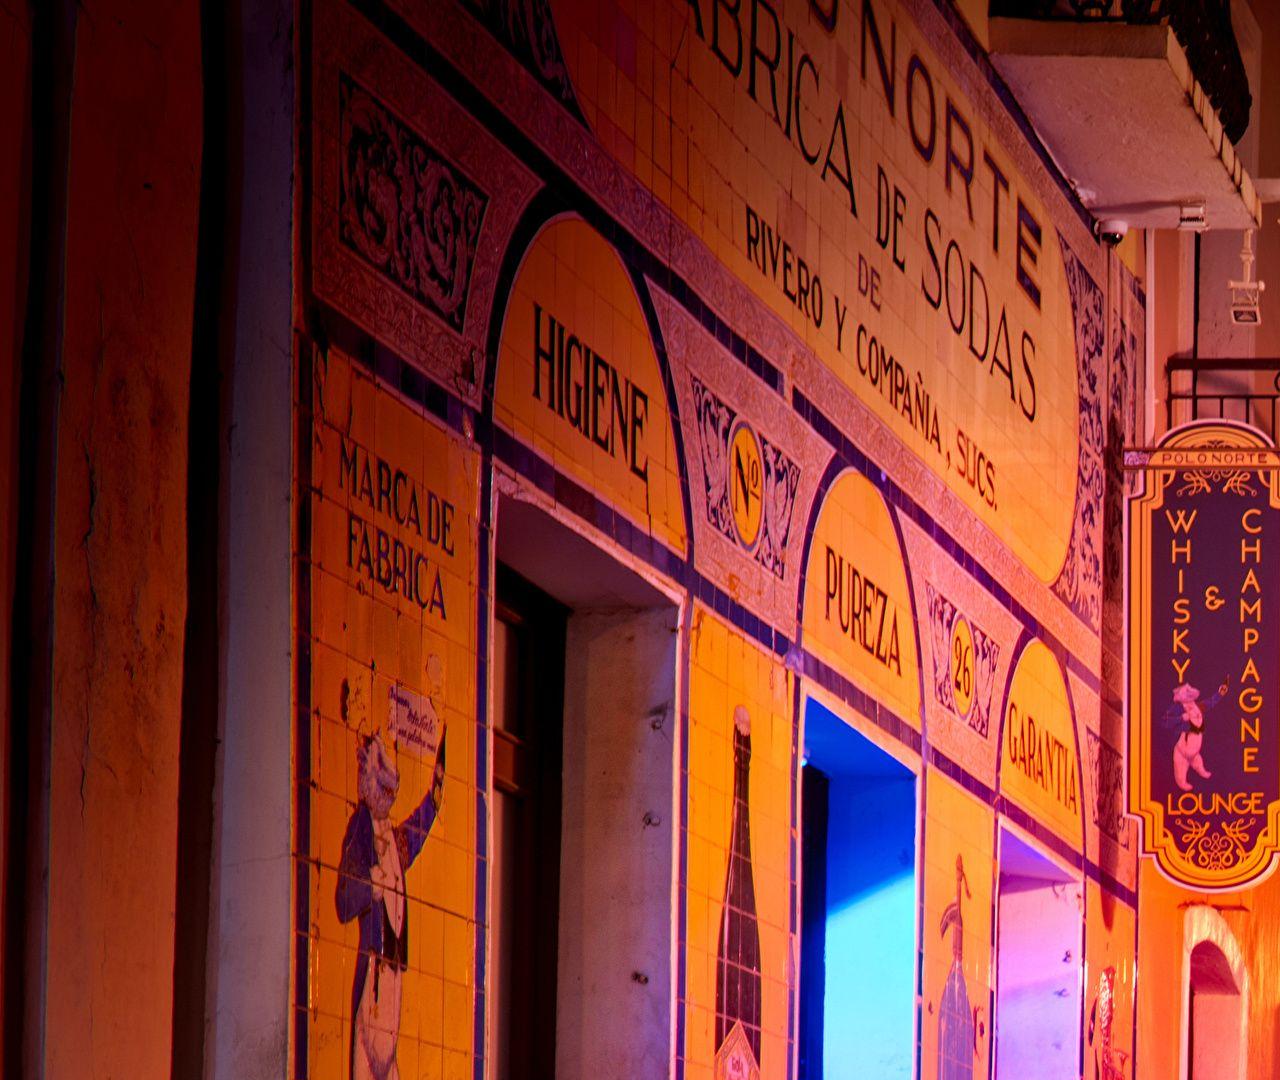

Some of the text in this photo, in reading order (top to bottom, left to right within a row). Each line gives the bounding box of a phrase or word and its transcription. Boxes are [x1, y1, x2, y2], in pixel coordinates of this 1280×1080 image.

[860, 0, 1043, 313] NORTE
[858, 252, 882, 313] DE
[876, 163, 907, 274] DE
[921, 207, 1037, 423] SODAS
[532, 301, 649, 483] HIGIENE
[746, 204, 824, 329] RIVERO
[833, 297, 847, 354] Y
[956, 428, 998, 512] SUCS.
[338, 432, 455, 558] MARCA DE
[1162, 452, 1268, 465] POLO NORTE
[346, 508, 447, 621] FABRICA
[824, 546, 902, 678] PUREZA
[1165, 509, 1198, 684] WHISKY
[1205, 585, 1226, 611] &
[955, 636, 971, 699] 26
[1239, 508, 1263, 773] CHAMPAGNE
[1008, 702, 1077, 816] GARANTIA
[1168, 792, 1265, 816] LOUNGE
